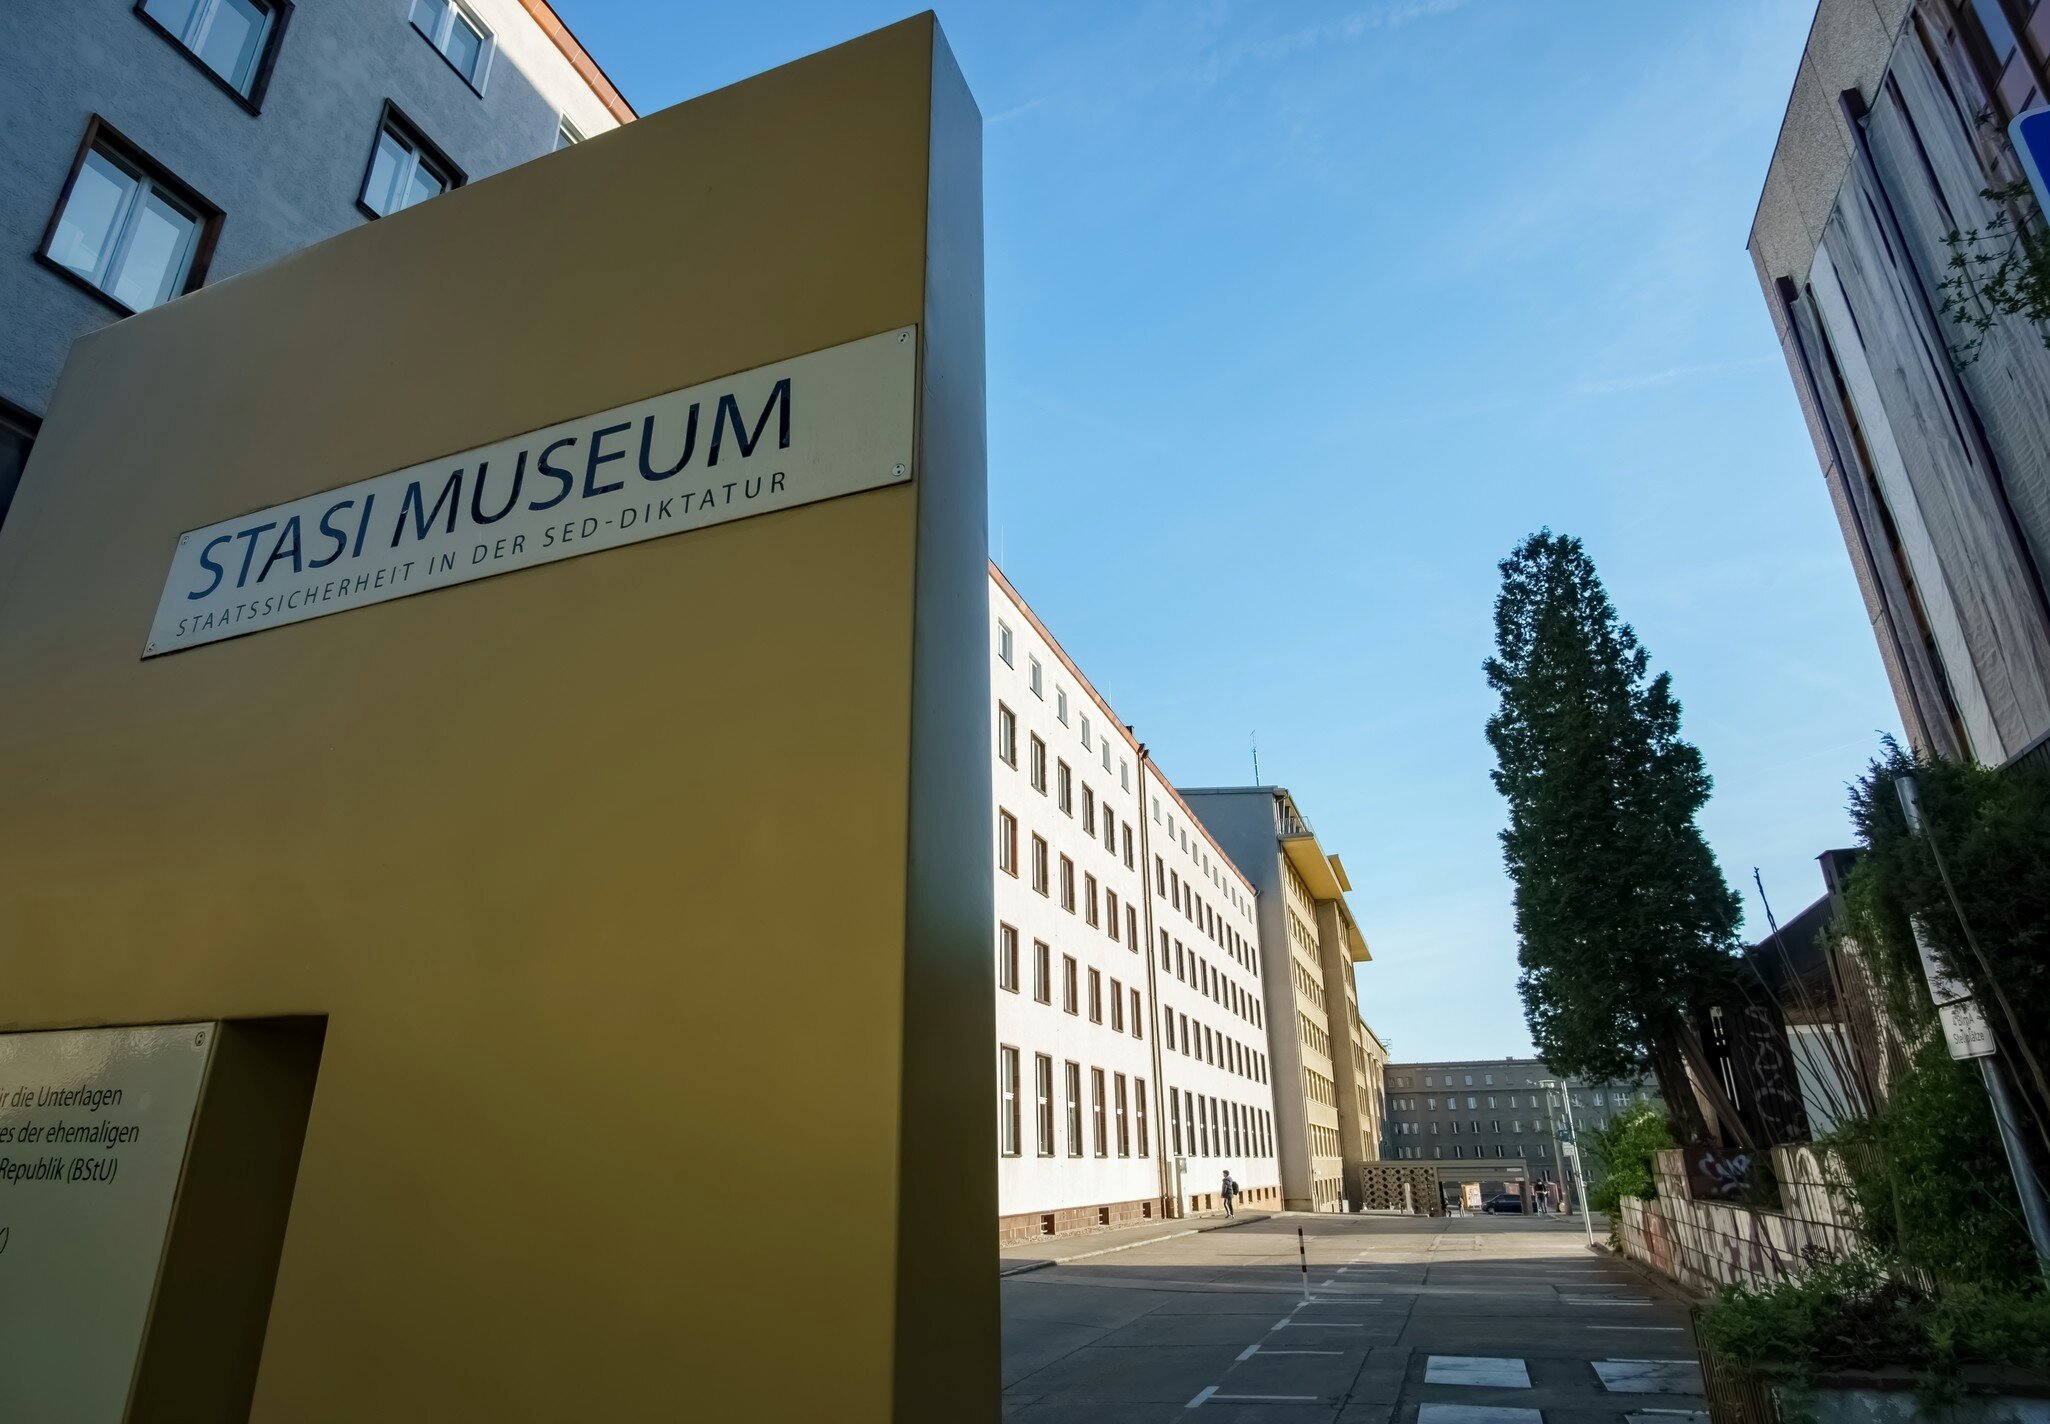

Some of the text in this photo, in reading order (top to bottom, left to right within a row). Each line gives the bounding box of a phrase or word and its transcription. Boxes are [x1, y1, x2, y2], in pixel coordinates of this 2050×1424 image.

[187, 377, 791, 600] STASI MUSEUM
[176, 472, 787, 637] STAATSSICHERHEIT IN DER SED-DIKTATUR
[11, 1086, 35, 1107] die
[38, 1084, 123, 1112] Unterlagen
[18, 1121, 45, 1143] der
[46, 1120, 140, 1149] ehemaligen
[0, 1157, 119, 1186] Republik (BStU)
